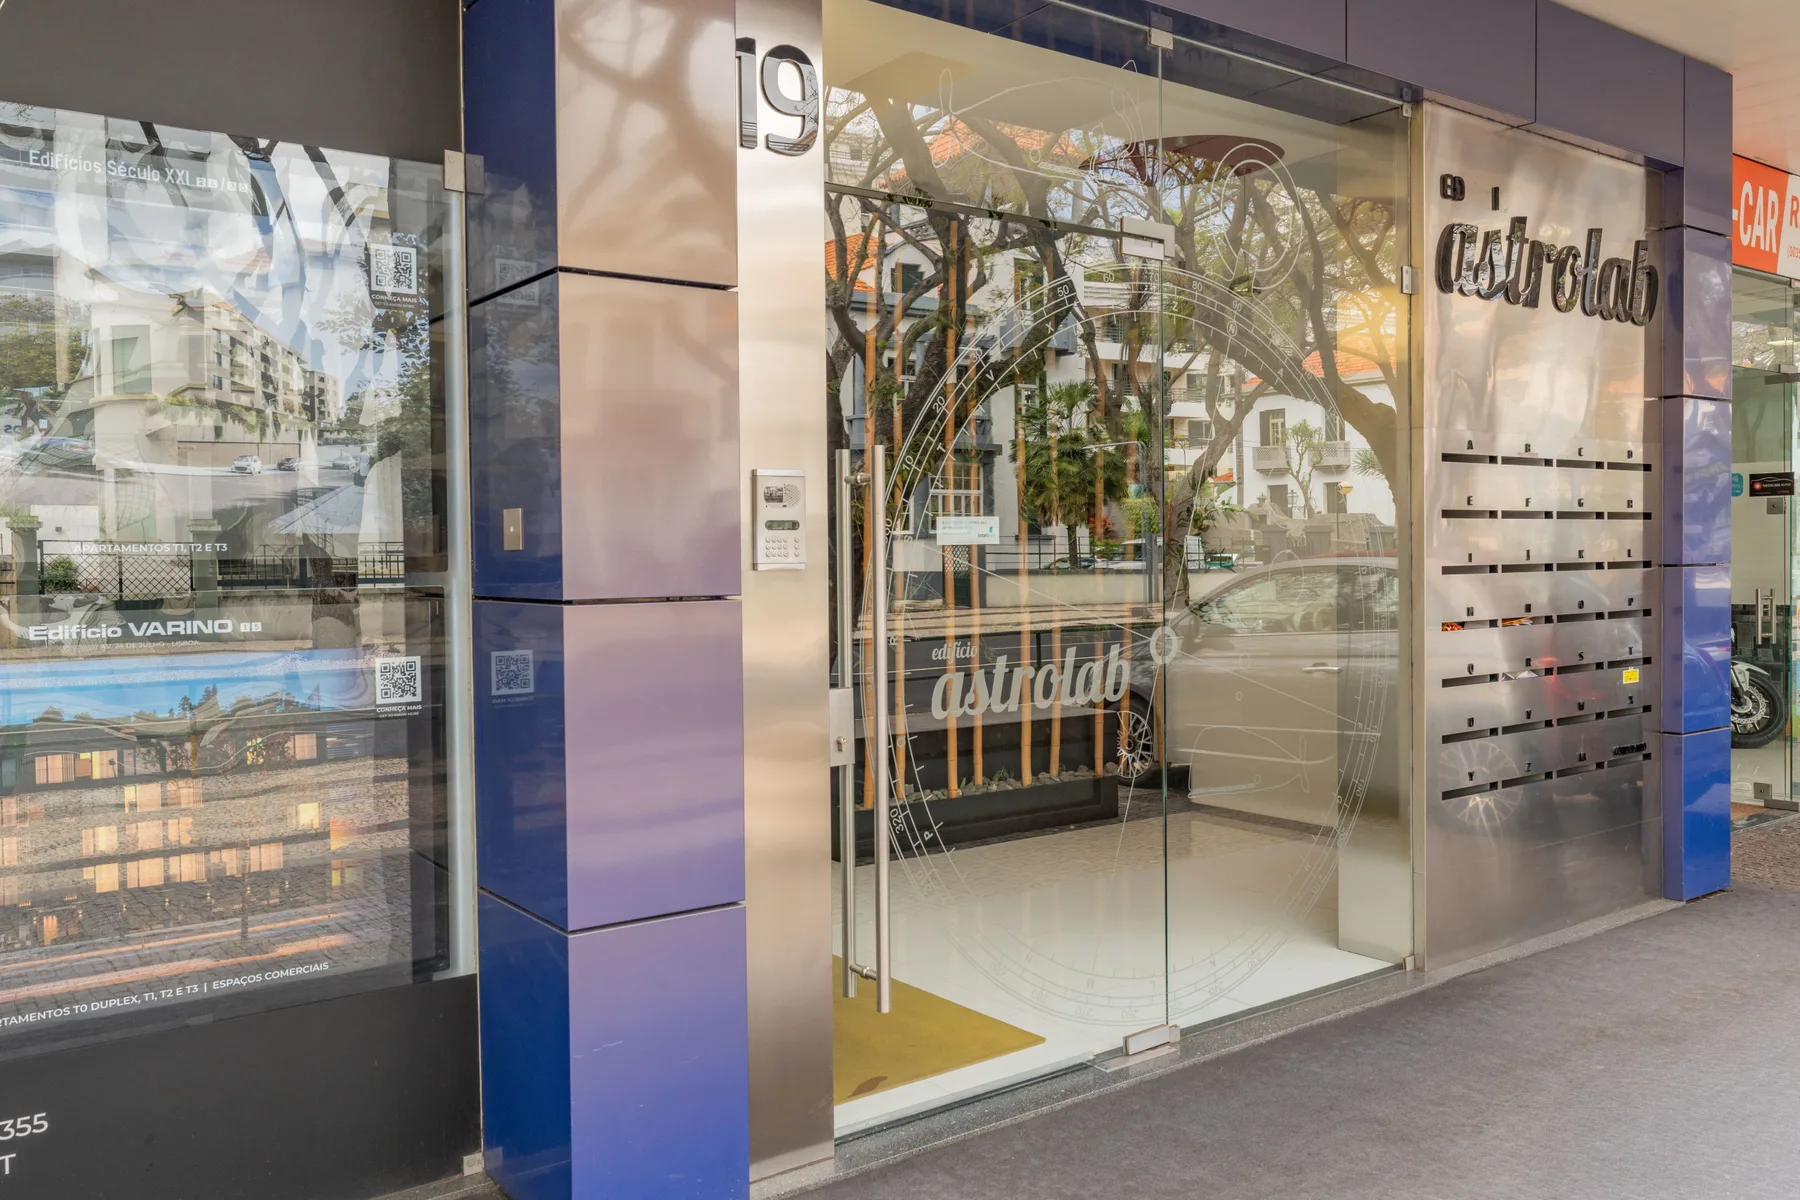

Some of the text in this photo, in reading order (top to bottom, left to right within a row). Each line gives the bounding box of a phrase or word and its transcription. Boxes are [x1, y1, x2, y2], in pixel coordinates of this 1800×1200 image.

[735, 37, 819, 156] 19
[28, 149, 101, 173] Edifícios
[107, 160, 160, 182] Século
[164, 168, 190, 186] XXI
[1103, 273, 1115, 282] 60
[1435, 216, 1659, 326] astrolab
[1057, 284, 1070, 297] 50
[1192, 280, 1202, 291] 80
[1172, 301, 1178, 312] Z
[1232, 300, 1242, 312] 90
[1045, 322, 1054, 334] X
[970, 348, 983, 363] 30
[986, 370, 996, 382] V
[932, 396, 946, 414] 20
[936, 442, 947, 454] T
[902, 455, 914, 472] 10
[73, 543, 170, 553] APARTAMENTOS
[189, 543, 202, 552] T2
[205, 544, 212, 552] E
[214, 543, 228, 552] T3
[28, 623, 122, 641] Edifício
[128, 619, 233, 637] VARINO
[932, 642, 978, 663] edifício
[931, 643, 1131, 720] astrolab
[1356, 778, 1364, 797] 190
[890, 808, 904, 834] 320
[924, 830, 933, 841] P
[0, 1007, 70, 1026] TAMENTOS
[91, 994, 141, 1011] DUPLEX,
[160, 988, 174, 999] T2
[176, 986, 184, 996] E
[185, 984, 198, 994] T3
[212, 974, 262, 989] ESPAÇOS
[264, 962, 329, 980] COMERCIAIS
[0, 1112, 48, 1140] 355
